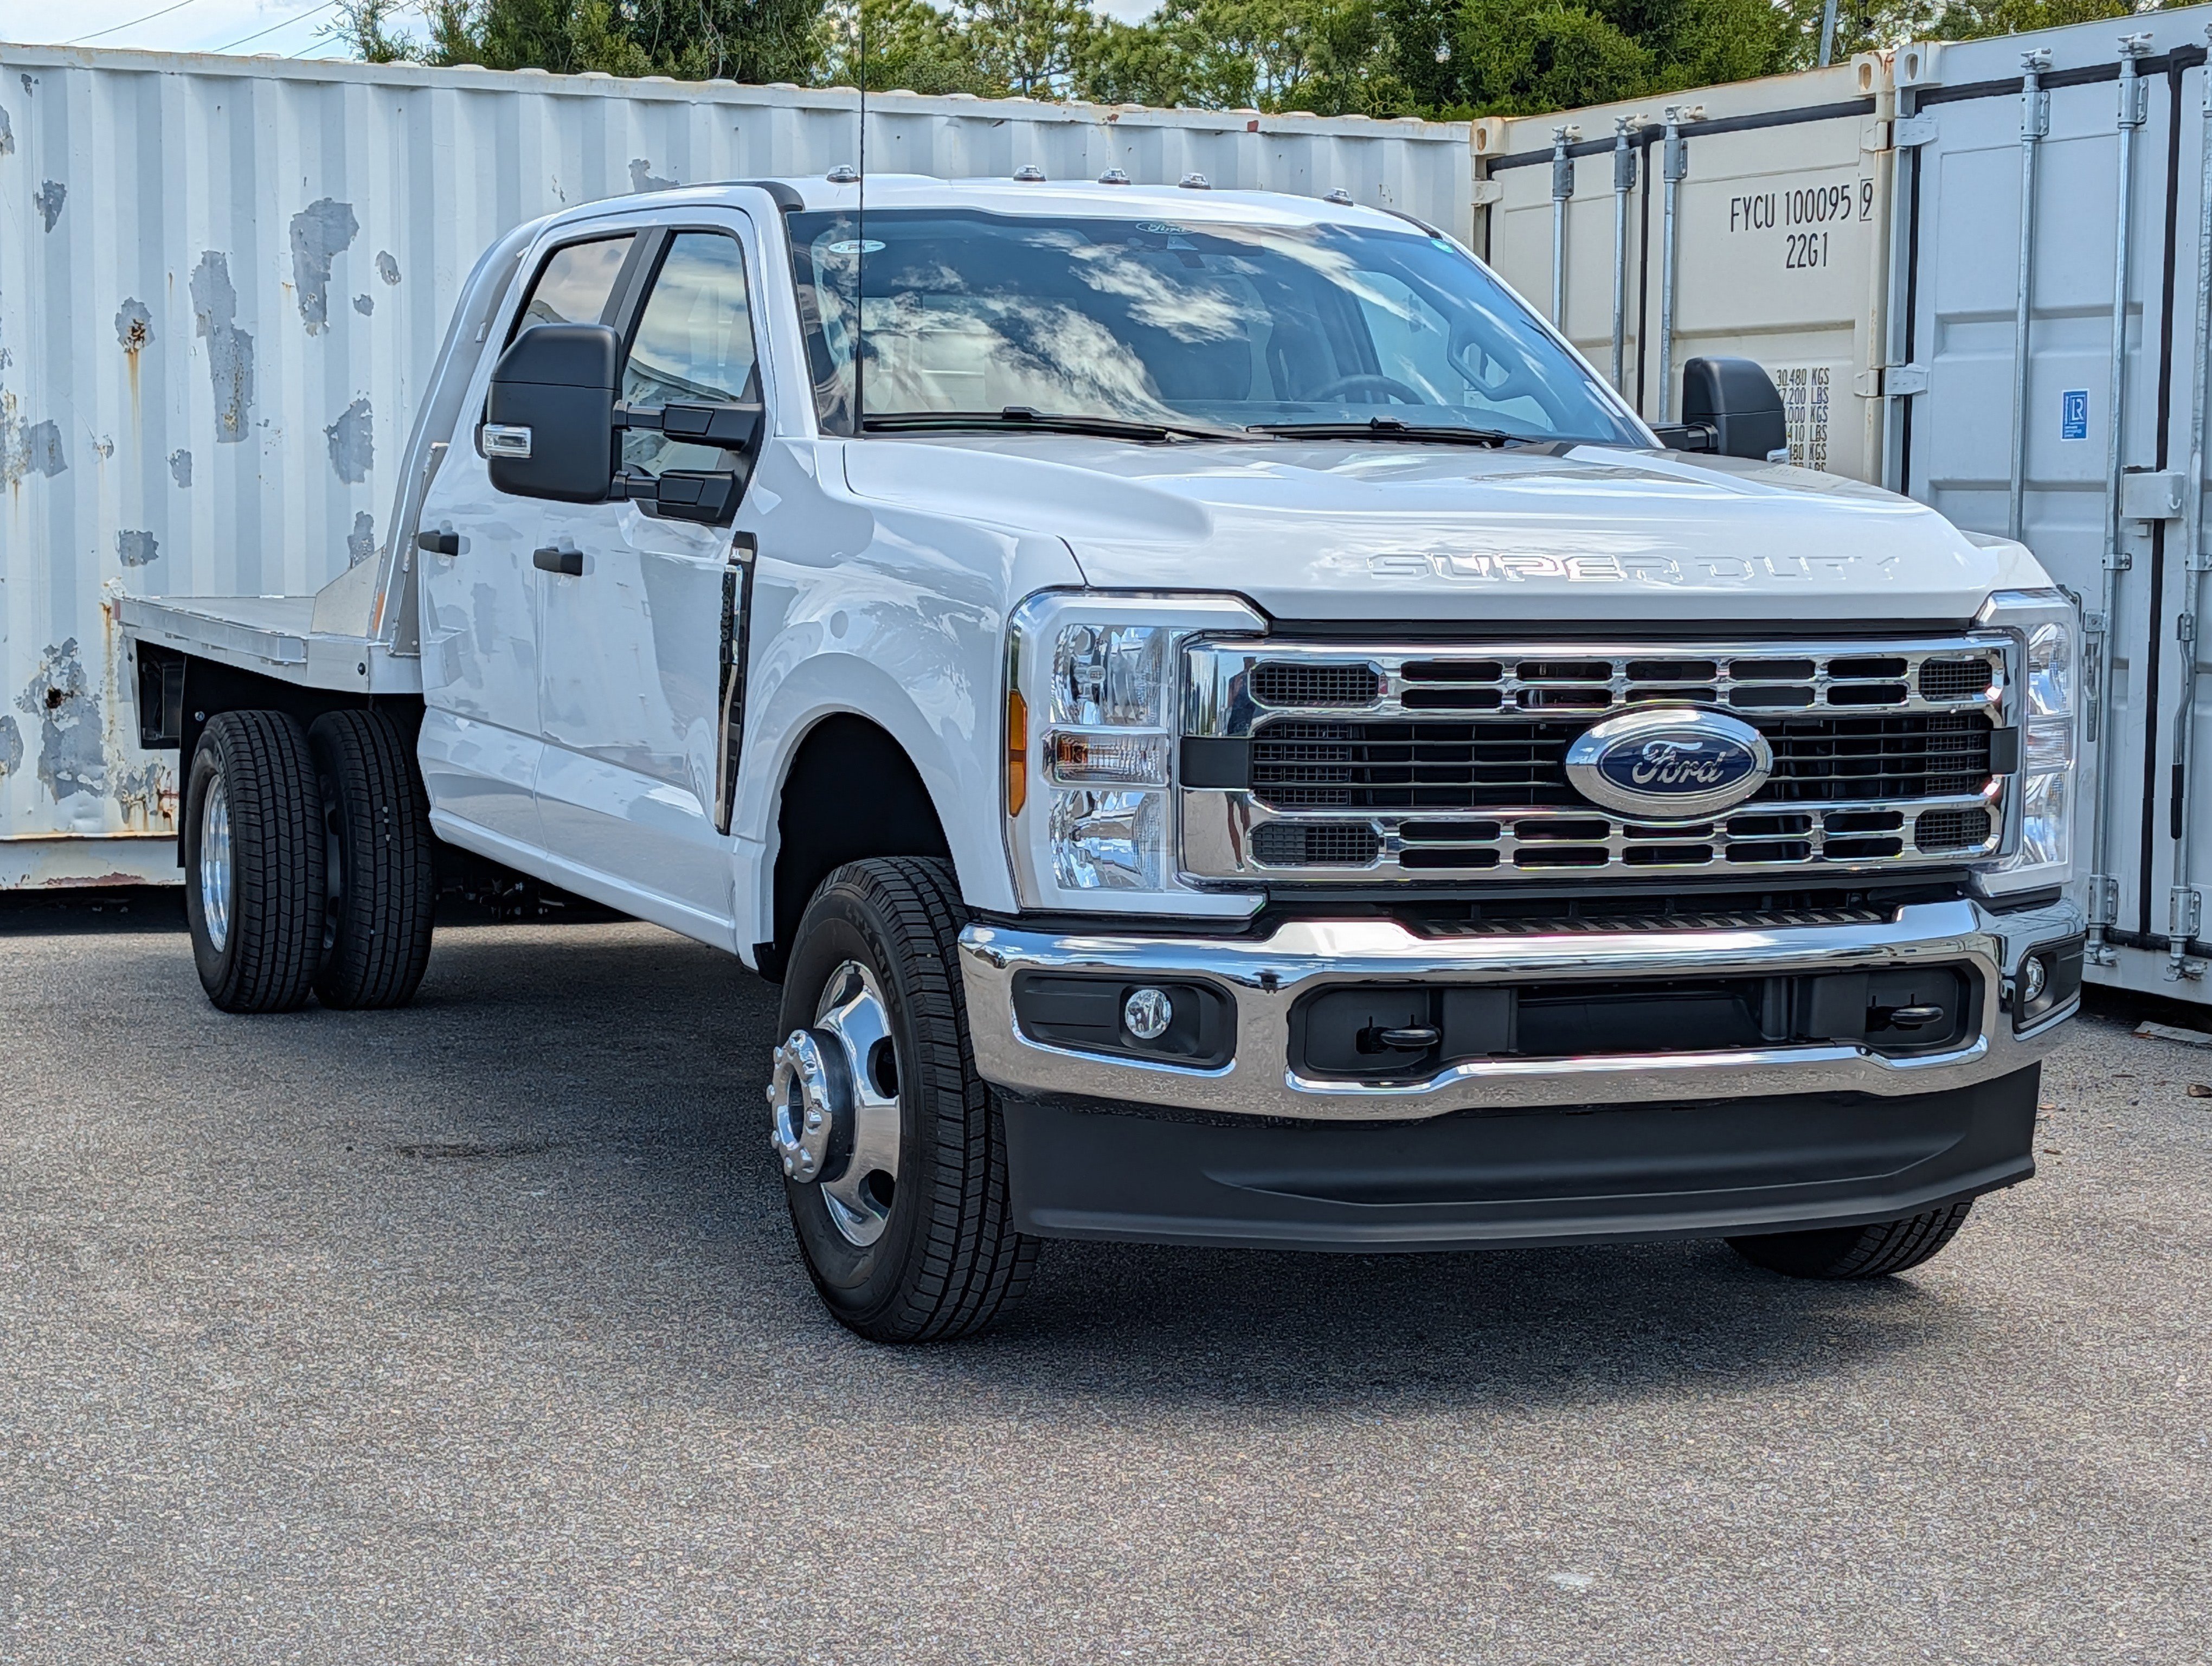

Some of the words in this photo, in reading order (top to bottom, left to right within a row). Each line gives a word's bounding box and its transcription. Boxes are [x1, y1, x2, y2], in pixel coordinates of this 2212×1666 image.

[1730, 193, 1776, 233] FYCU
[1785, 184, 1851, 226] 100095
[1861, 181, 1874, 219] 9
[1786, 231, 1828, 269] 22G1
[1811, 367, 1830, 386] KGS
[1811, 387, 1829, 405] LBS
[1810, 405, 1829, 424] KGS
[1809, 424, 1828, 442] LBS
[1809, 443, 1827, 461] KGS
[1365, 552, 1684, 583] SUPER
[1694, 554, 1900, 581] DUTY
[1631, 740, 1727, 784] Ford
